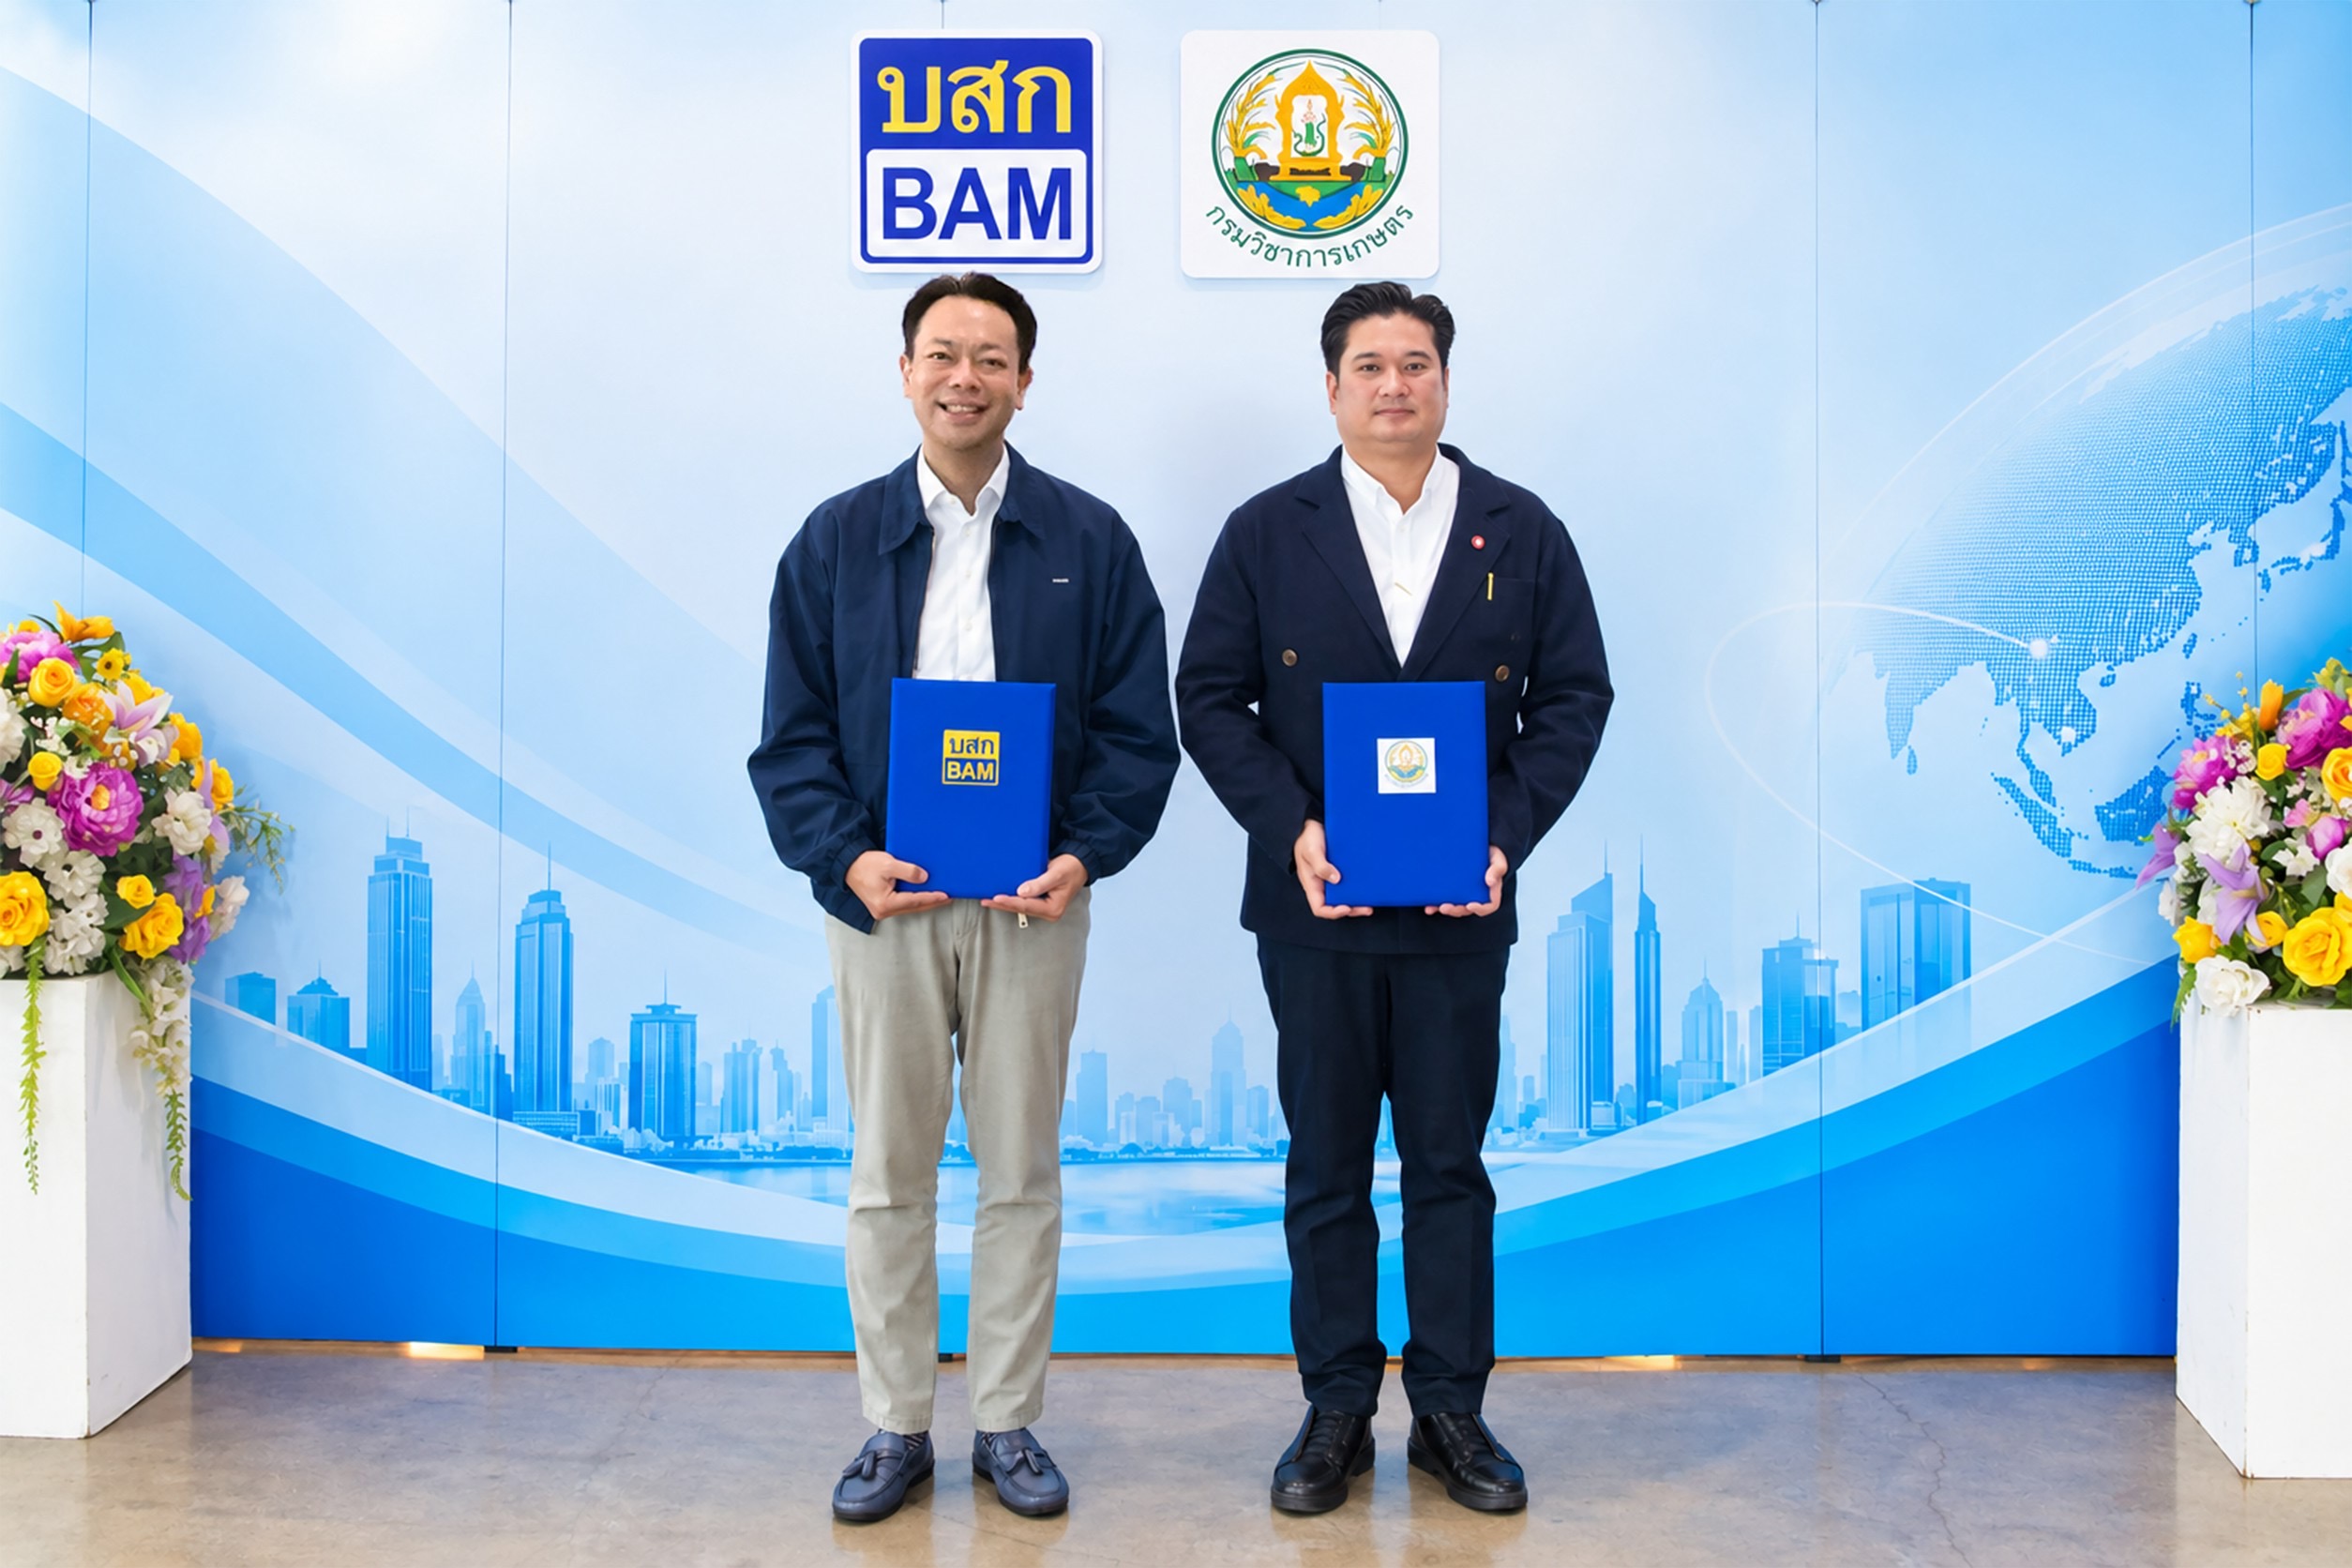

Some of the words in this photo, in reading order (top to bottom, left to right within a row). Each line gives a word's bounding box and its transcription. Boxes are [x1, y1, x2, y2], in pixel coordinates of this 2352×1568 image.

[877, 60, 1072, 133] บสก
[882, 167, 1072, 240] BAM
[1206, 205, 1414, 268] กรมวิชาการเกษตร
[947, 761, 994, 780] BAM
